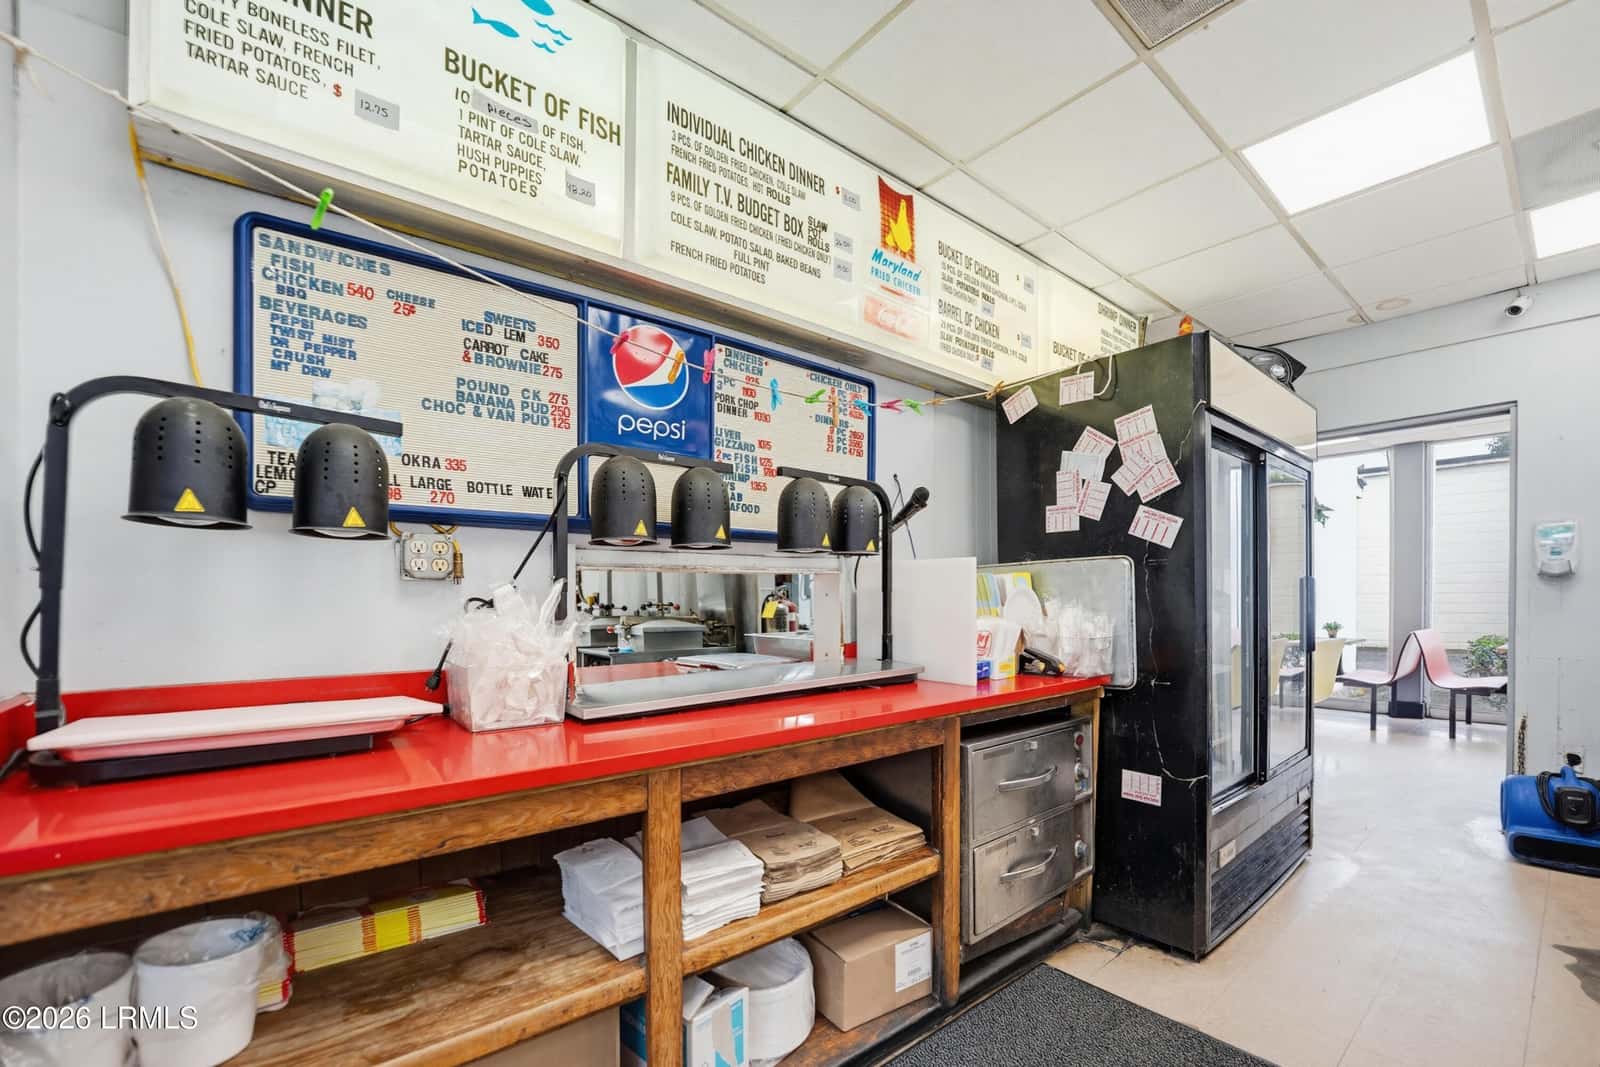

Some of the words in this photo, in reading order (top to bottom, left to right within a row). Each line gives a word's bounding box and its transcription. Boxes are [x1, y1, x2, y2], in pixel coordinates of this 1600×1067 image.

[184, 0, 230, 28] COLE
[294, 42, 354, 77] FRENCH
[248, 2, 330, 47] BONELESS
[184, 19, 234, 51] FRIED
[332, 83, 343, 98] $
[185, 41, 249, 79] TARTAR
[256, 68, 309, 100] SAUCE
[444, 46, 537, 108] BUCKET
[544, 92, 571, 121] OF
[578, 106, 621, 146] FISH
[457, 124, 503, 153] TARTAR
[468, 110, 497, 132] PINT
[500, 123, 516, 139] OF
[518, 131, 547, 154] COLE
[542, 124, 557, 140] OF
[666, 99, 736, 153] INDIVIDUAL
[738, 136, 787, 177] CHICKEN
[788, 161, 826, 196] DINNER
[694, 139, 703, 151] OF
[704, 143, 730, 166] GOLDEN
[730, 155, 749, 173] FRIED
[457, 142, 491, 167] HUSH
[494, 155, 543, 186] PUPPIES
[671, 143, 698, 165] FRENCH
[698, 156, 718, 175] FRIED
[752, 180, 765, 195] HOT
[766, 184, 792, 207] ROLLS
[666, 160, 711, 199] FAMILY
[713, 182, 733, 210] T.V.
[737, 192, 780, 229] BUDGET
[783, 213, 805, 240] BOX
[694, 200, 703, 213] OF
[704, 203, 730, 224] GOLDEN
[730, 215, 749, 233] FRIED
[749, 223, 775, 242] CHICKEN
[807, 215, 829, 234] SLAW
[258, 233, 391, 276] SANDWICHES
[670, 210, 692, 229] COLE
[719, 228, 749, 252] POTATO
[776, 252, 800, 271] BAKED
[799, 261, 823, 279] BEANS
[807, 234, 831, 254] ROLLS
[270, 253, 315, 276] FISH
[670, 240, 704, 263] FRENCH
[704, 252, 729, 272] FRIED
[729, 263, 767, 285] POTATOES
[733, 250, 752, 265] FULL
[753, 257, 771, 273] PINT
[871, 247, 923, 282] Maryland
[938, 239, 963, 265] BUCKET
[964, 255, 973, 272] OF
[974, 260, 999, 288] CHICKEN
[262, 266, 344, 297] CHICKEN
[346, 281, 375, 301] 540
[385, 289, 436, 310] CHEESE
[276, 283, 308, 300] BBQ
[870, 265, 892, 284] FRIED
[893, 276, 922, 297] CHICKEN
[259, 295, 369, 329] BEVERAGES
[270, 312, 314, 330] PEPSI
[483, 310, 537, 333] SWEETS
[938, 298, 963, 325] BARREL
[964, 311, 973, 328] OF
[974, 315, 999, 340] CHICKEN
[269, 323, 314, 342] TWIST
[321, 333, 356, 349] MIST
[270, 335, 290, 349] DR
[303, 342, 358, 361] PEPPER
[461, 319, 493, 336] ICED
[503, 327, 526, 344] LEM
[536, 334, 561, 351] 350
[271, 348, 326, 367] CRUSH
[462, 350, 472, 364] &
[474, 353, 542, 376] BROWNIE
[542, 365, 564, 380] 275
[463, 337, 510, 357] CARROT
[519, 348, 551, 365] CAKE
[1052, 340, 1077, 363] BUCKET
[270, 359, 291, 372] MT
[301, 364, 332, 379] DEW
[723, 357, 764, 377] CHICKEN
[456, 376, 510, 397] POUND
[520, 388, 542, 402] CK
[548, 391, 569, 406] 275
[456, 390, 516, 410] BANANA
[520, 400, 550, 416] PUD
[550, 405, 571, 419] 250
[715, 391, 737, 406] PORK
[737, 397, 760, 411] CHOP
[421, 397, 466, 416] CHOC
[472, 405, 483, 418] &
[486, 407, 516, 423] VAN
[522, 412, 550, 428] PUD
[551, 417, 572, 430] 125
[716, 402, 748, 418] DINNER
[617, 413, 687, 442] pepsi
[715, 426, 741, 441] LIVER
[714, 437, 756, 453] GIZZARD
[716, 449, 722, 460] 2
[734, 452, 758, 466] FISH
[836, 445, 848, 456] PC
[401, 453, 441, 470] OKRA
[444, 457, 468, 472] 335
[735, 462, 758, 475] FISH
[254, 478, 277, 495] CP
[430, 490, 456, 505] 270
[410, 474, 453, 491] LARGE
[466, 480, 514, 497] BOTTLE
